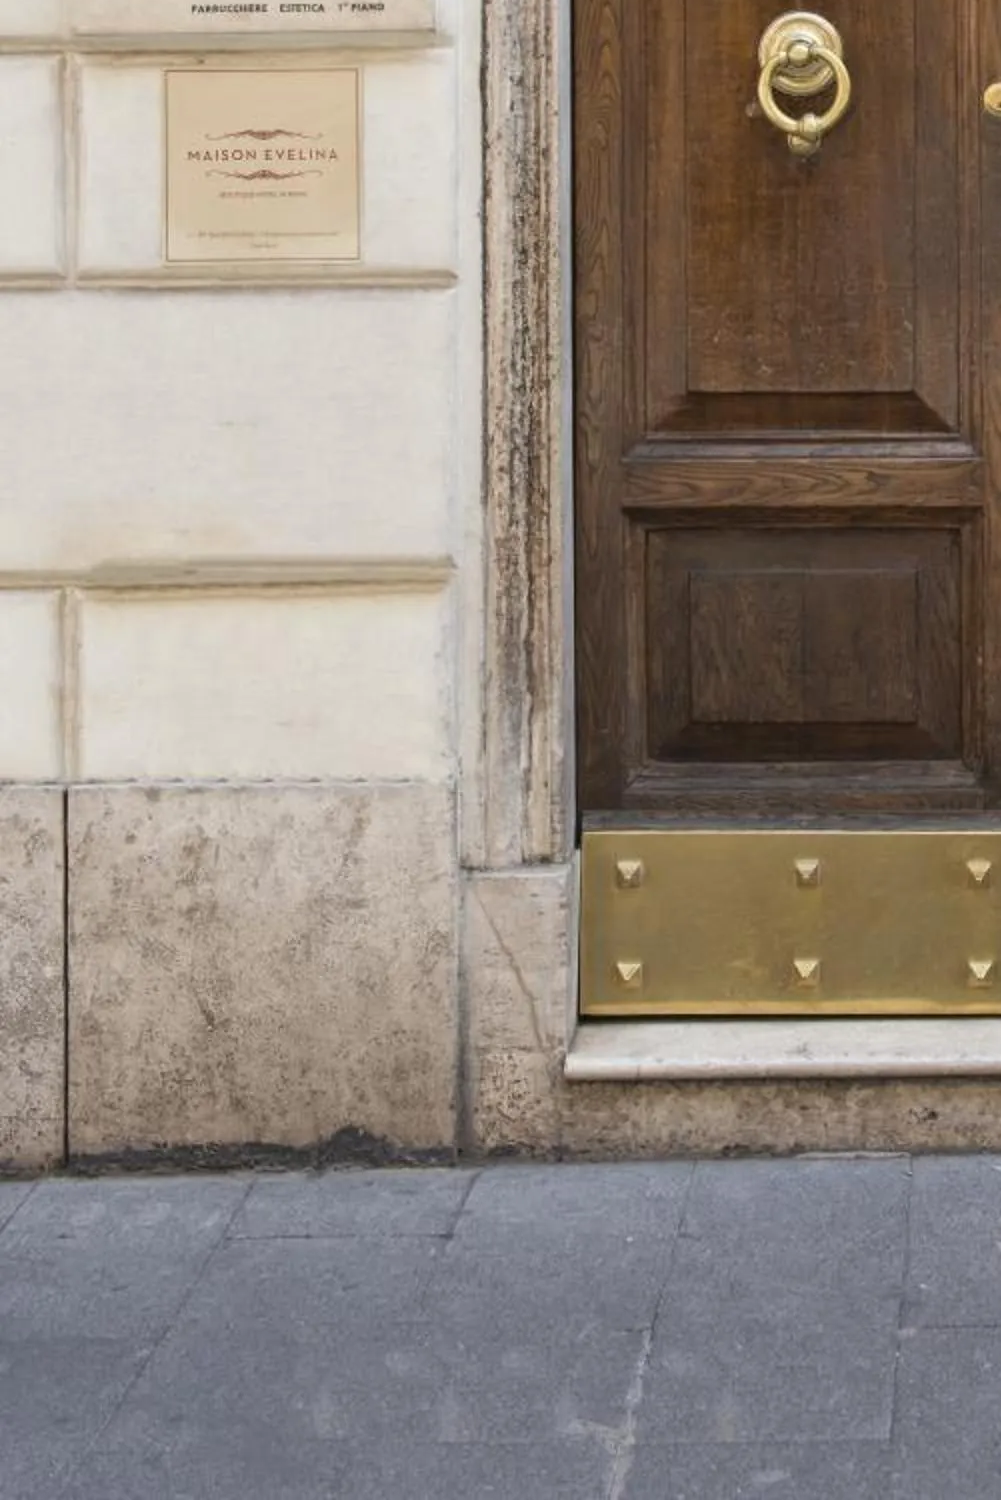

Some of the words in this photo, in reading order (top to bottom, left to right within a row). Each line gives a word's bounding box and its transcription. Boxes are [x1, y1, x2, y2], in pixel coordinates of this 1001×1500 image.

[351, 2, 385, 12] PIANO
[187, 149, 257, 162] MAISON
[264, 147, 339, 161] EVELINA
